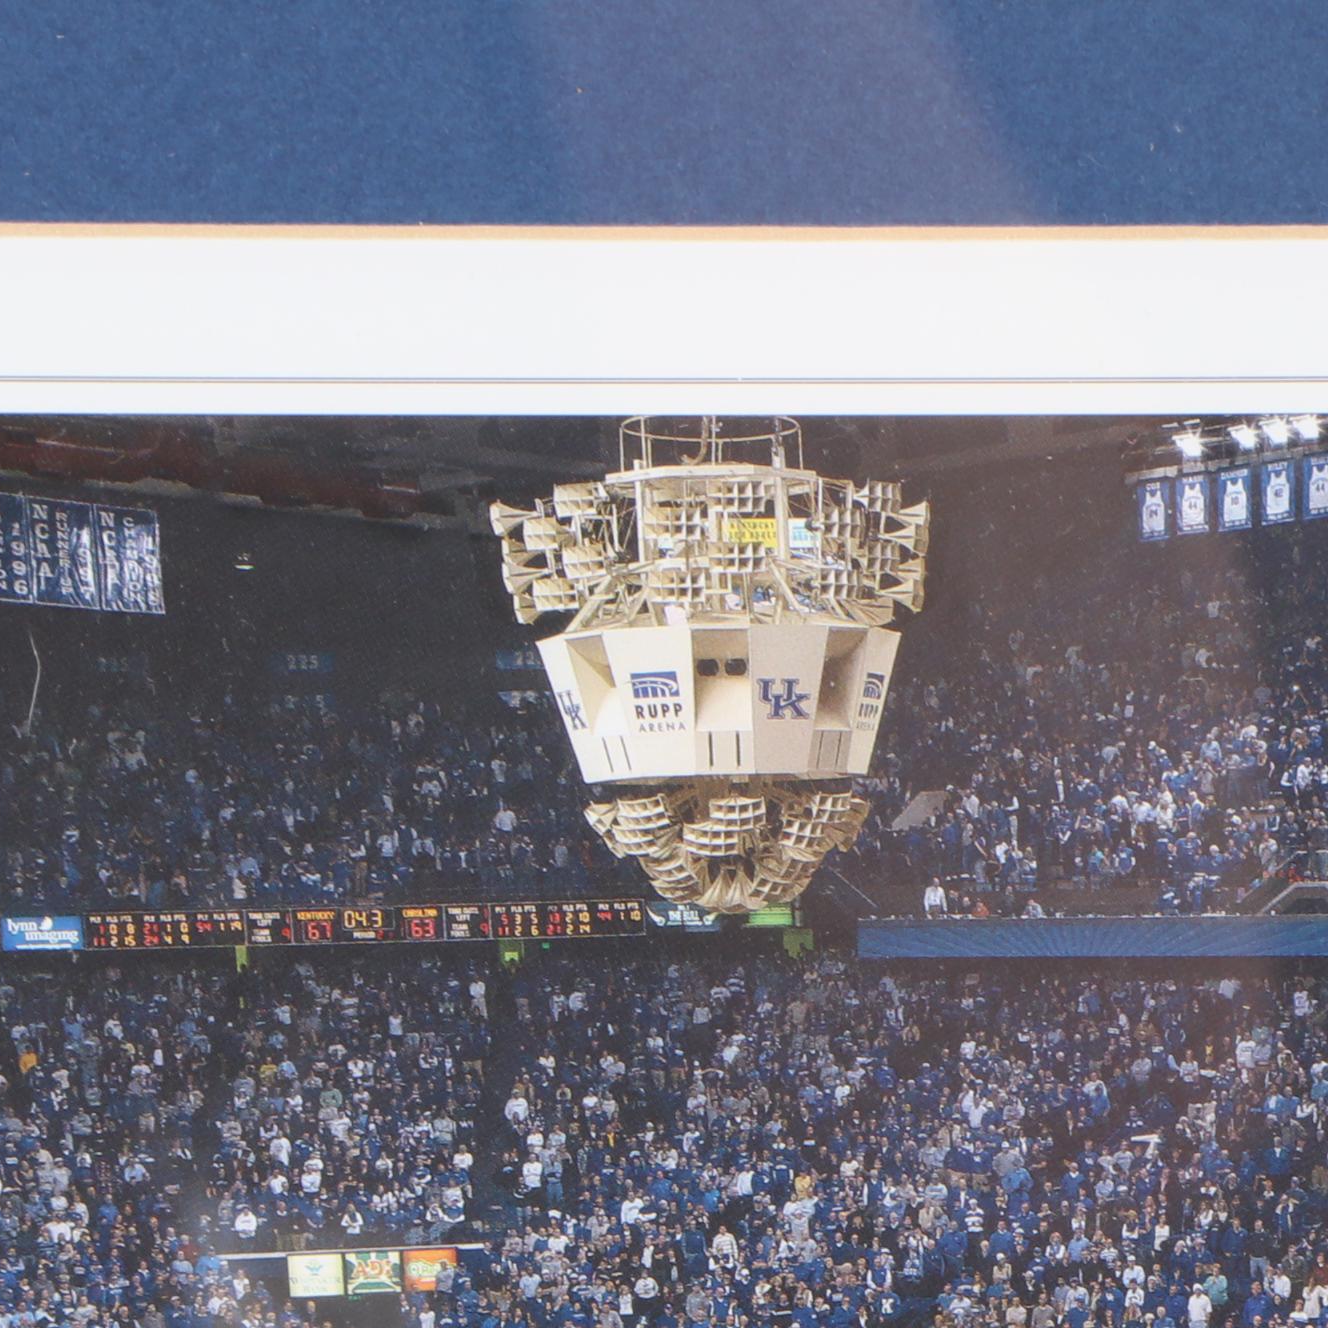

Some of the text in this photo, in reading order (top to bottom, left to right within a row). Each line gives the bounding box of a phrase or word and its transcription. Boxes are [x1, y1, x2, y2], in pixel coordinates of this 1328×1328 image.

[31, 503, 54, 578] NCAA
[757, 678, 812, 720] UK
[634, 702, 684, 720] RUPP
[638, 721, 686, 733] ARENA
[297, 911, 336, 920] KENTUCKY
[343, 910, 383, 929] 04.3
[514, 914, 522, 924] 3
[530, 913, 537, 923] 5
[566, 912, 573, 922] 2
[7, 918, 38, 934] lynn
[307, 922, 332, 940] 67
[411, 919, 435, 937] 63
[515, 926, 522, 936] 2
[531, 926, 539, 935] 6
[566, 925, 573, 935] 2
[110, 935, 118, 946] 2
